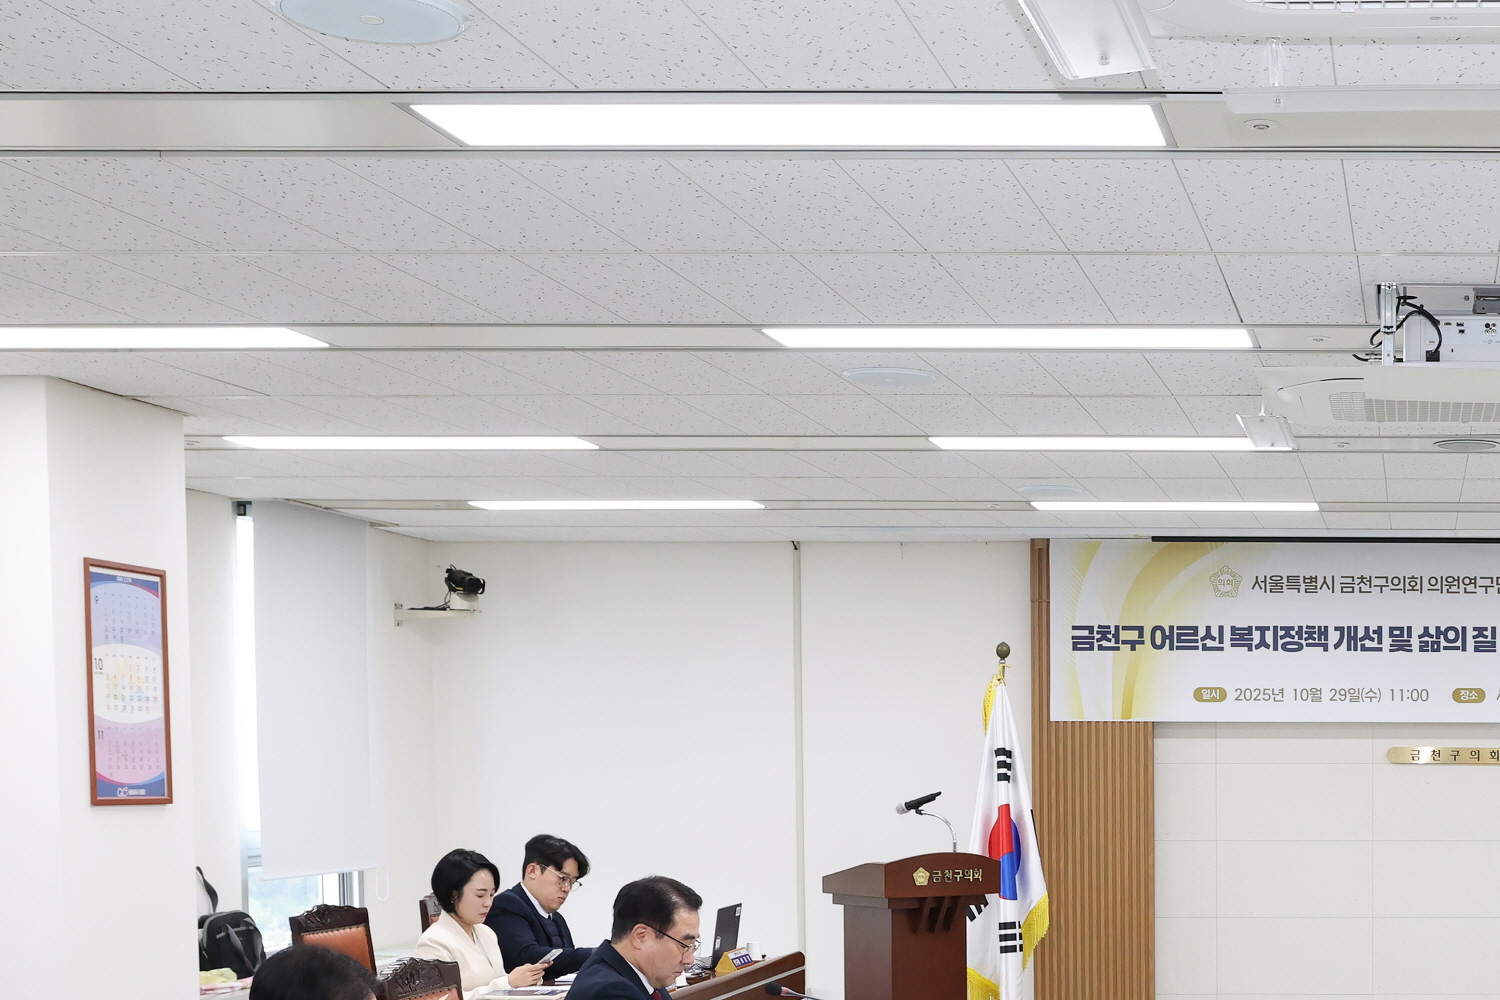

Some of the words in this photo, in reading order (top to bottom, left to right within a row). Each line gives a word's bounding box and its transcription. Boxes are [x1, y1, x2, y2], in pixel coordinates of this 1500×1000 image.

[1251, 574, 1335, 594] 서울특별시
[1339, 574, 1423, 594] 금천구의회
[1071, 624, 1146, 652] 금천구
[1149, 624, 1225, 652] 어르신
[1229, 625, 1329, 652] 복지정책
[1333, 625, 1383, 652] 개선
[1388, 625, 1413, 653] 및
[1417, 625, 1467, 653] 삶의
[1471, 626, 1497, 653] 질
[1201, 689, 1221, 700] 일시
[1234, 687, 1284, 703] 2025년
[1292, 687, 1322, 703] 10월
[1329, 687, 1382, 703] 29일(수)
[1390, 688, 1429, 702] 11:00
[1459, 689, 1479, 700] 장소
[1410, 749, 1500, 762] 금천구의회
[932, 868, 983, 883] 금천구의회
